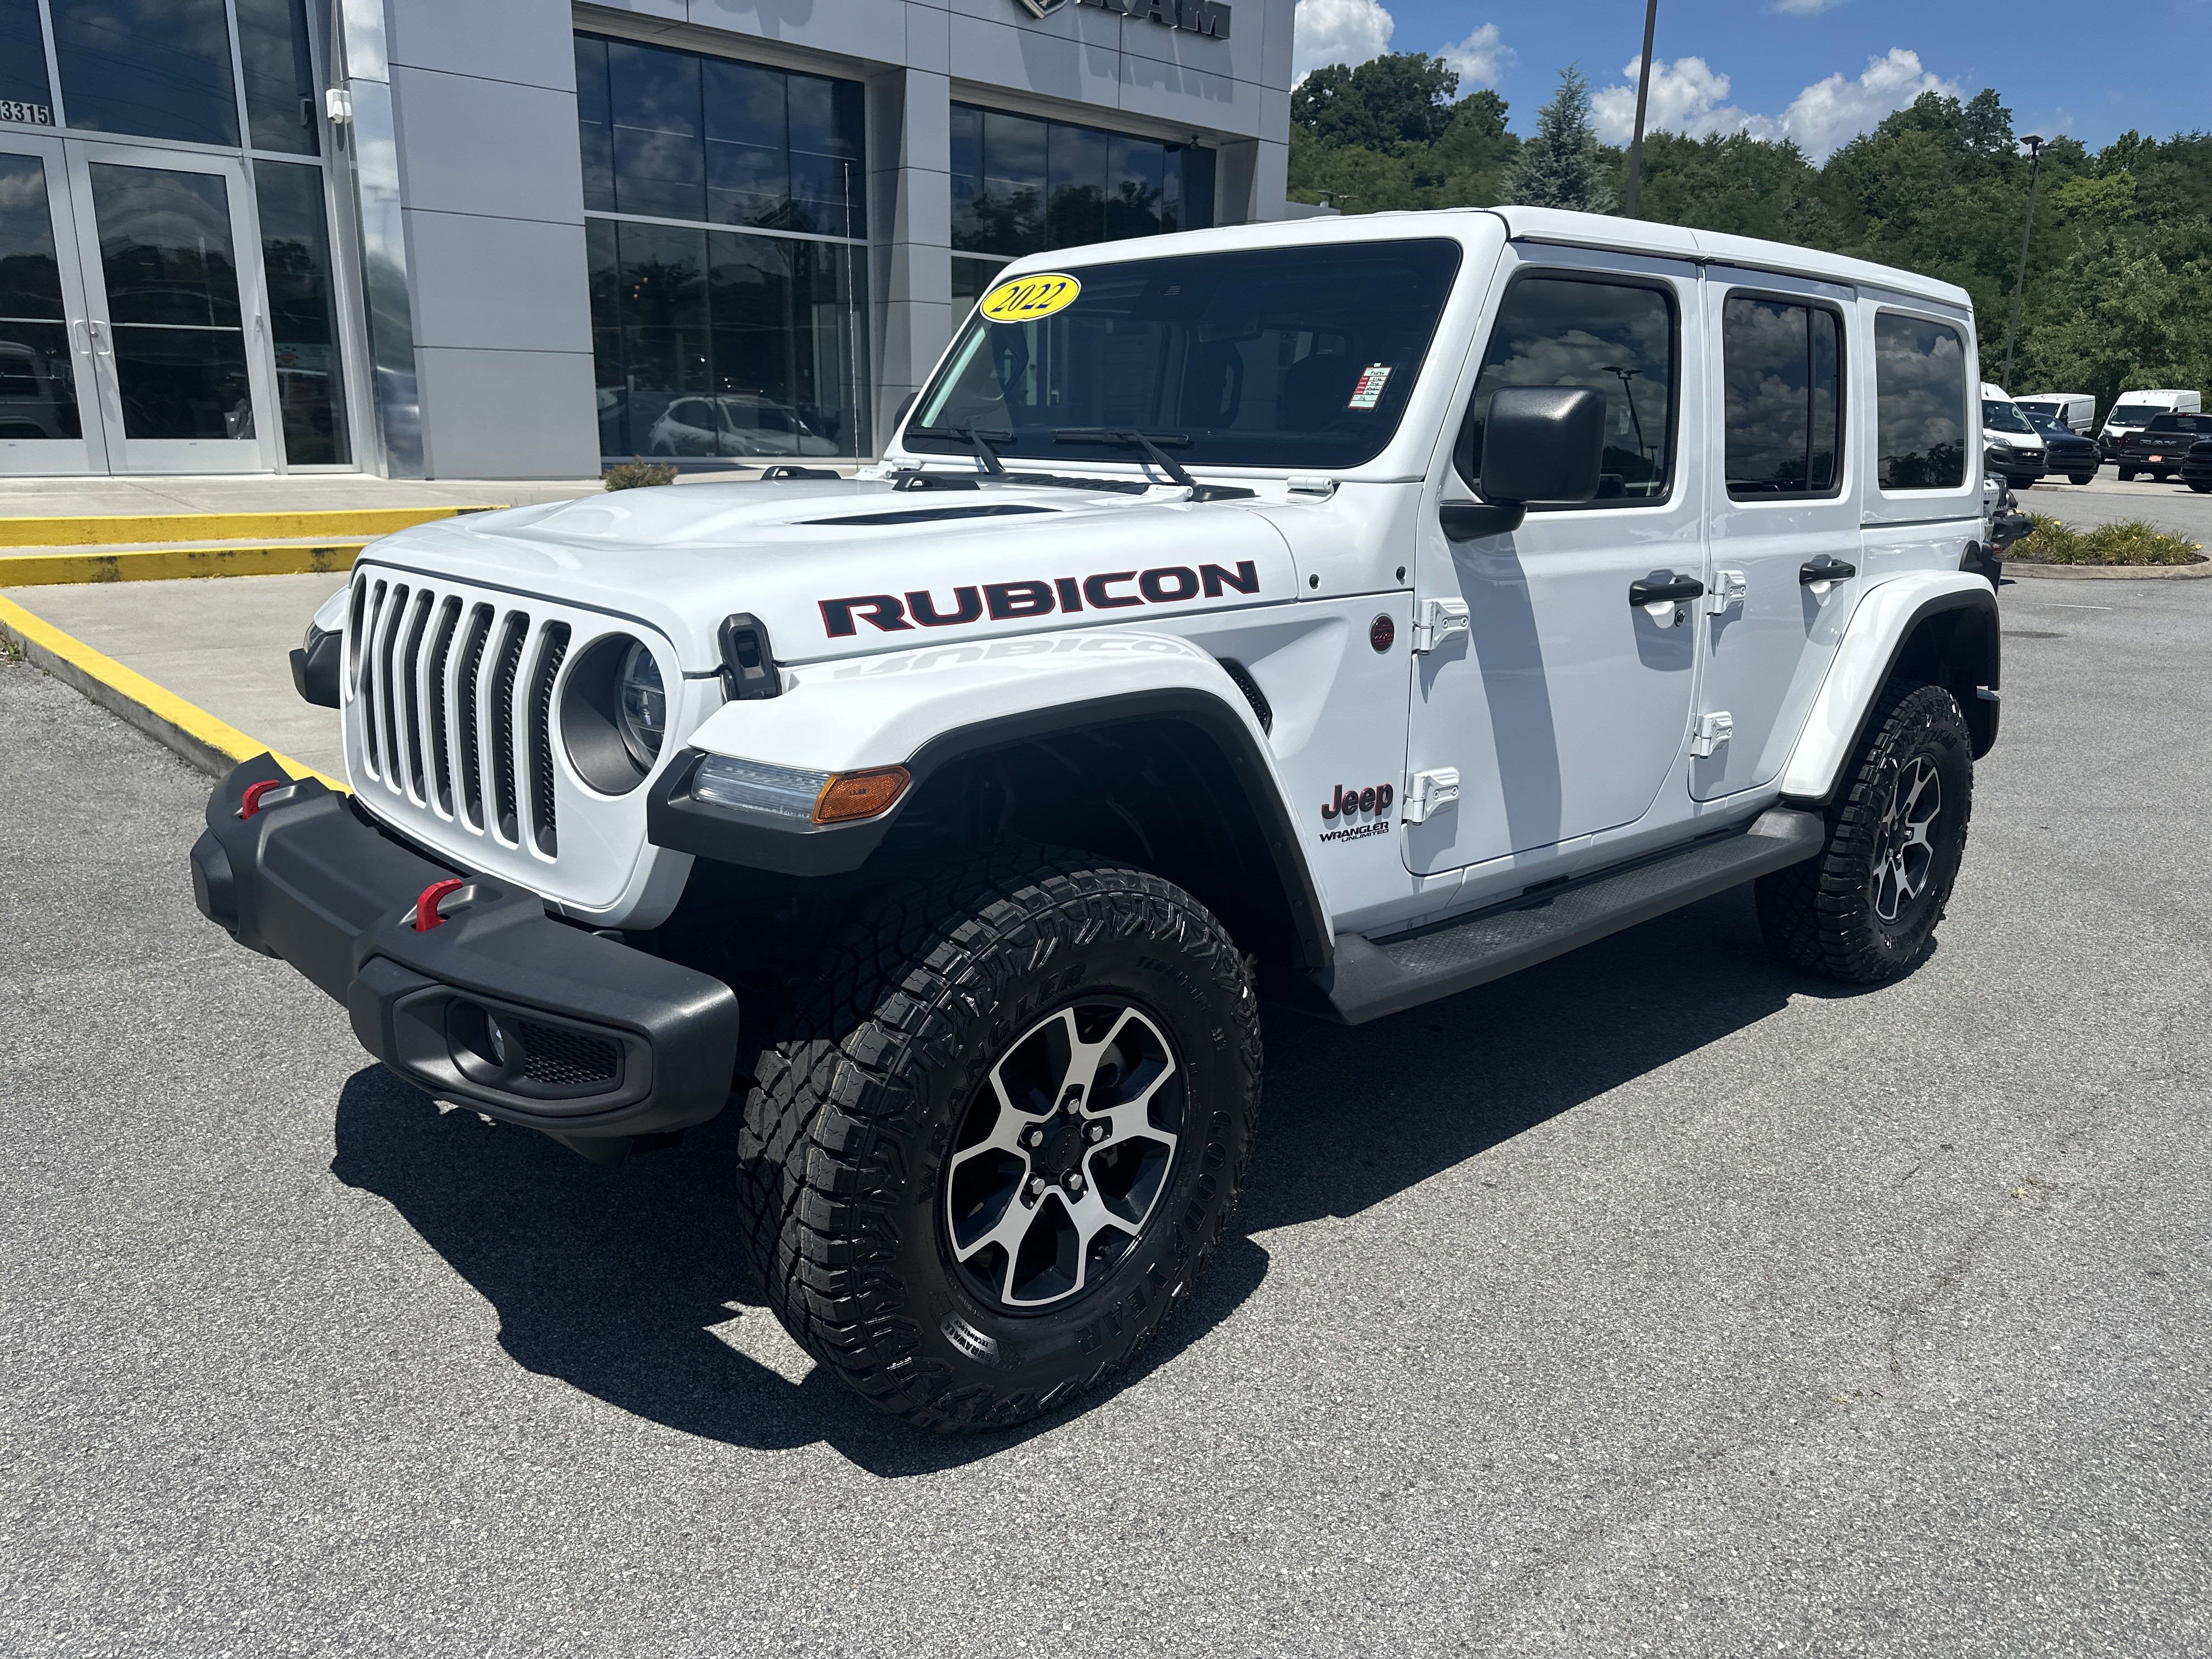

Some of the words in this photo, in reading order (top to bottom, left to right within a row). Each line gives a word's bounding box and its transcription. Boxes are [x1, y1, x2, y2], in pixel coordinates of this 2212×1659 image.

[2, 101, 48, 123] 3315
[989, 282, 1066, 313] 2022
[817, 560, 1260, 639] RUBICON
[1322, 783, 1393, 819] Jeep
[1319, 821, 1389, 842] WRANGLER
[1341, 828, 1389, 842] UNLIMITED
[1075, 1106, 1233, 1361] GOODYEAR
[943, 1319, 994, 1363] DURAWALL
